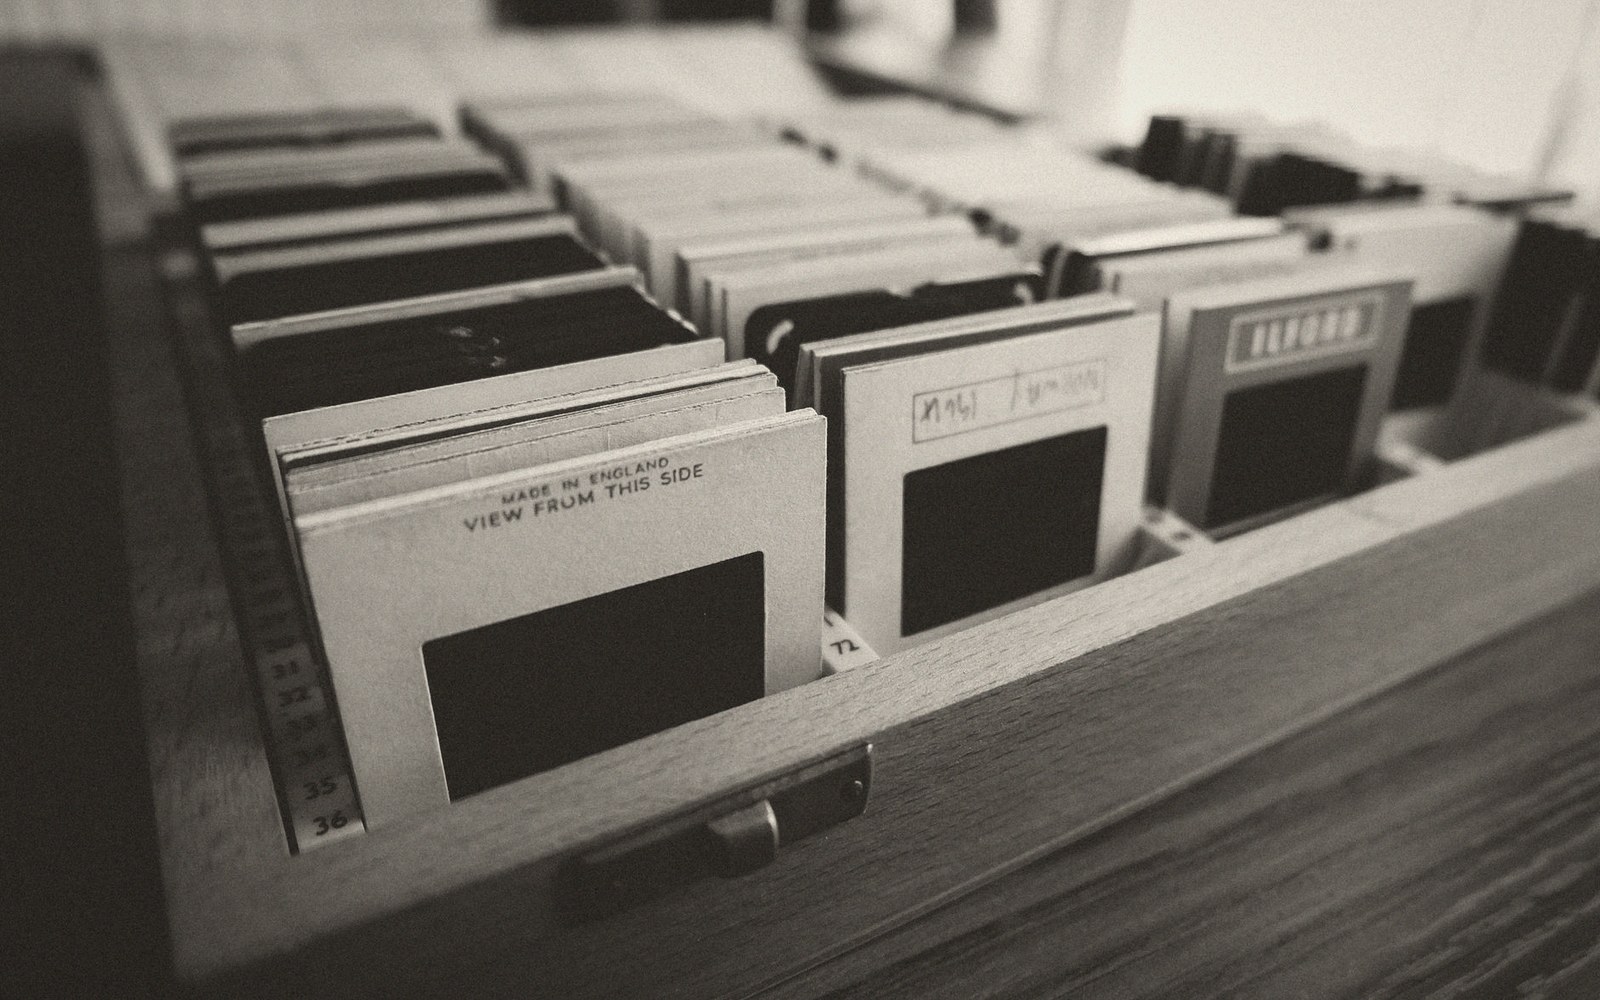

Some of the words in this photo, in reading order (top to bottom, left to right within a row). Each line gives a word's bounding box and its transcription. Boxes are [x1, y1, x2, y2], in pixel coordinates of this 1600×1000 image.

[501, 486, 550, 504] MADE
[562, 478, 579, 490] IN
[589, 457, 669, 485] ENGLAND
[463, 508, 523, 532] VIEW
[533, 491, 594, 517] FROM
[605, 476, 650, 499] THIS
[660, 463, 704, 486] SIDE
[830, 639, 859, 655] 72
[303, 776, 337, 800] 35
[313, 811, 348, 836] 36
